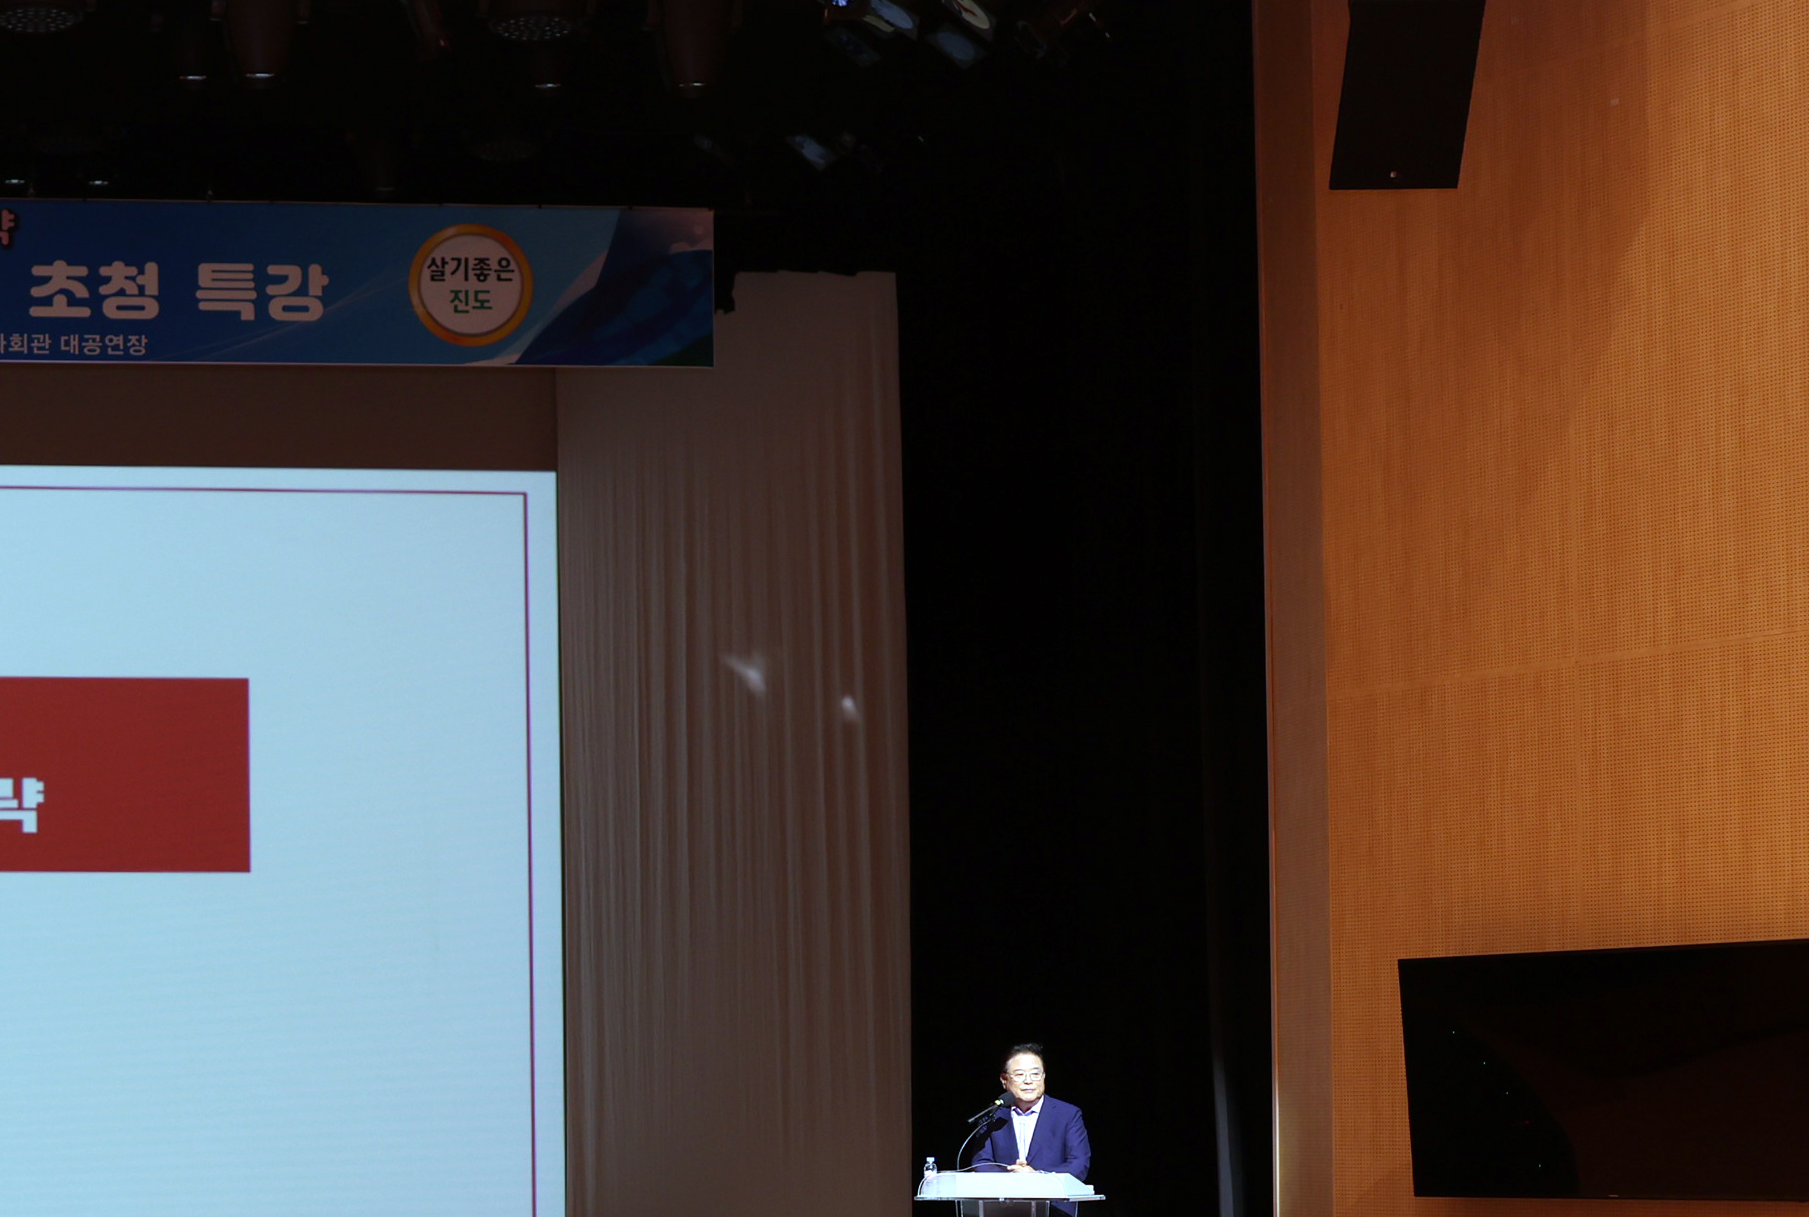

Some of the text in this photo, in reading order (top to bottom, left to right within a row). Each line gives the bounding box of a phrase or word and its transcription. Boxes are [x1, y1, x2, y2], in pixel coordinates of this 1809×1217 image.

[427, 257, 516, 282] 살기좋은
[29, 259, 160, 320] 초청
[195, 262, 330, 322] 특강
[449, 289, 493, 314] 진도
[60, 333, 149, 356] 대공연장
